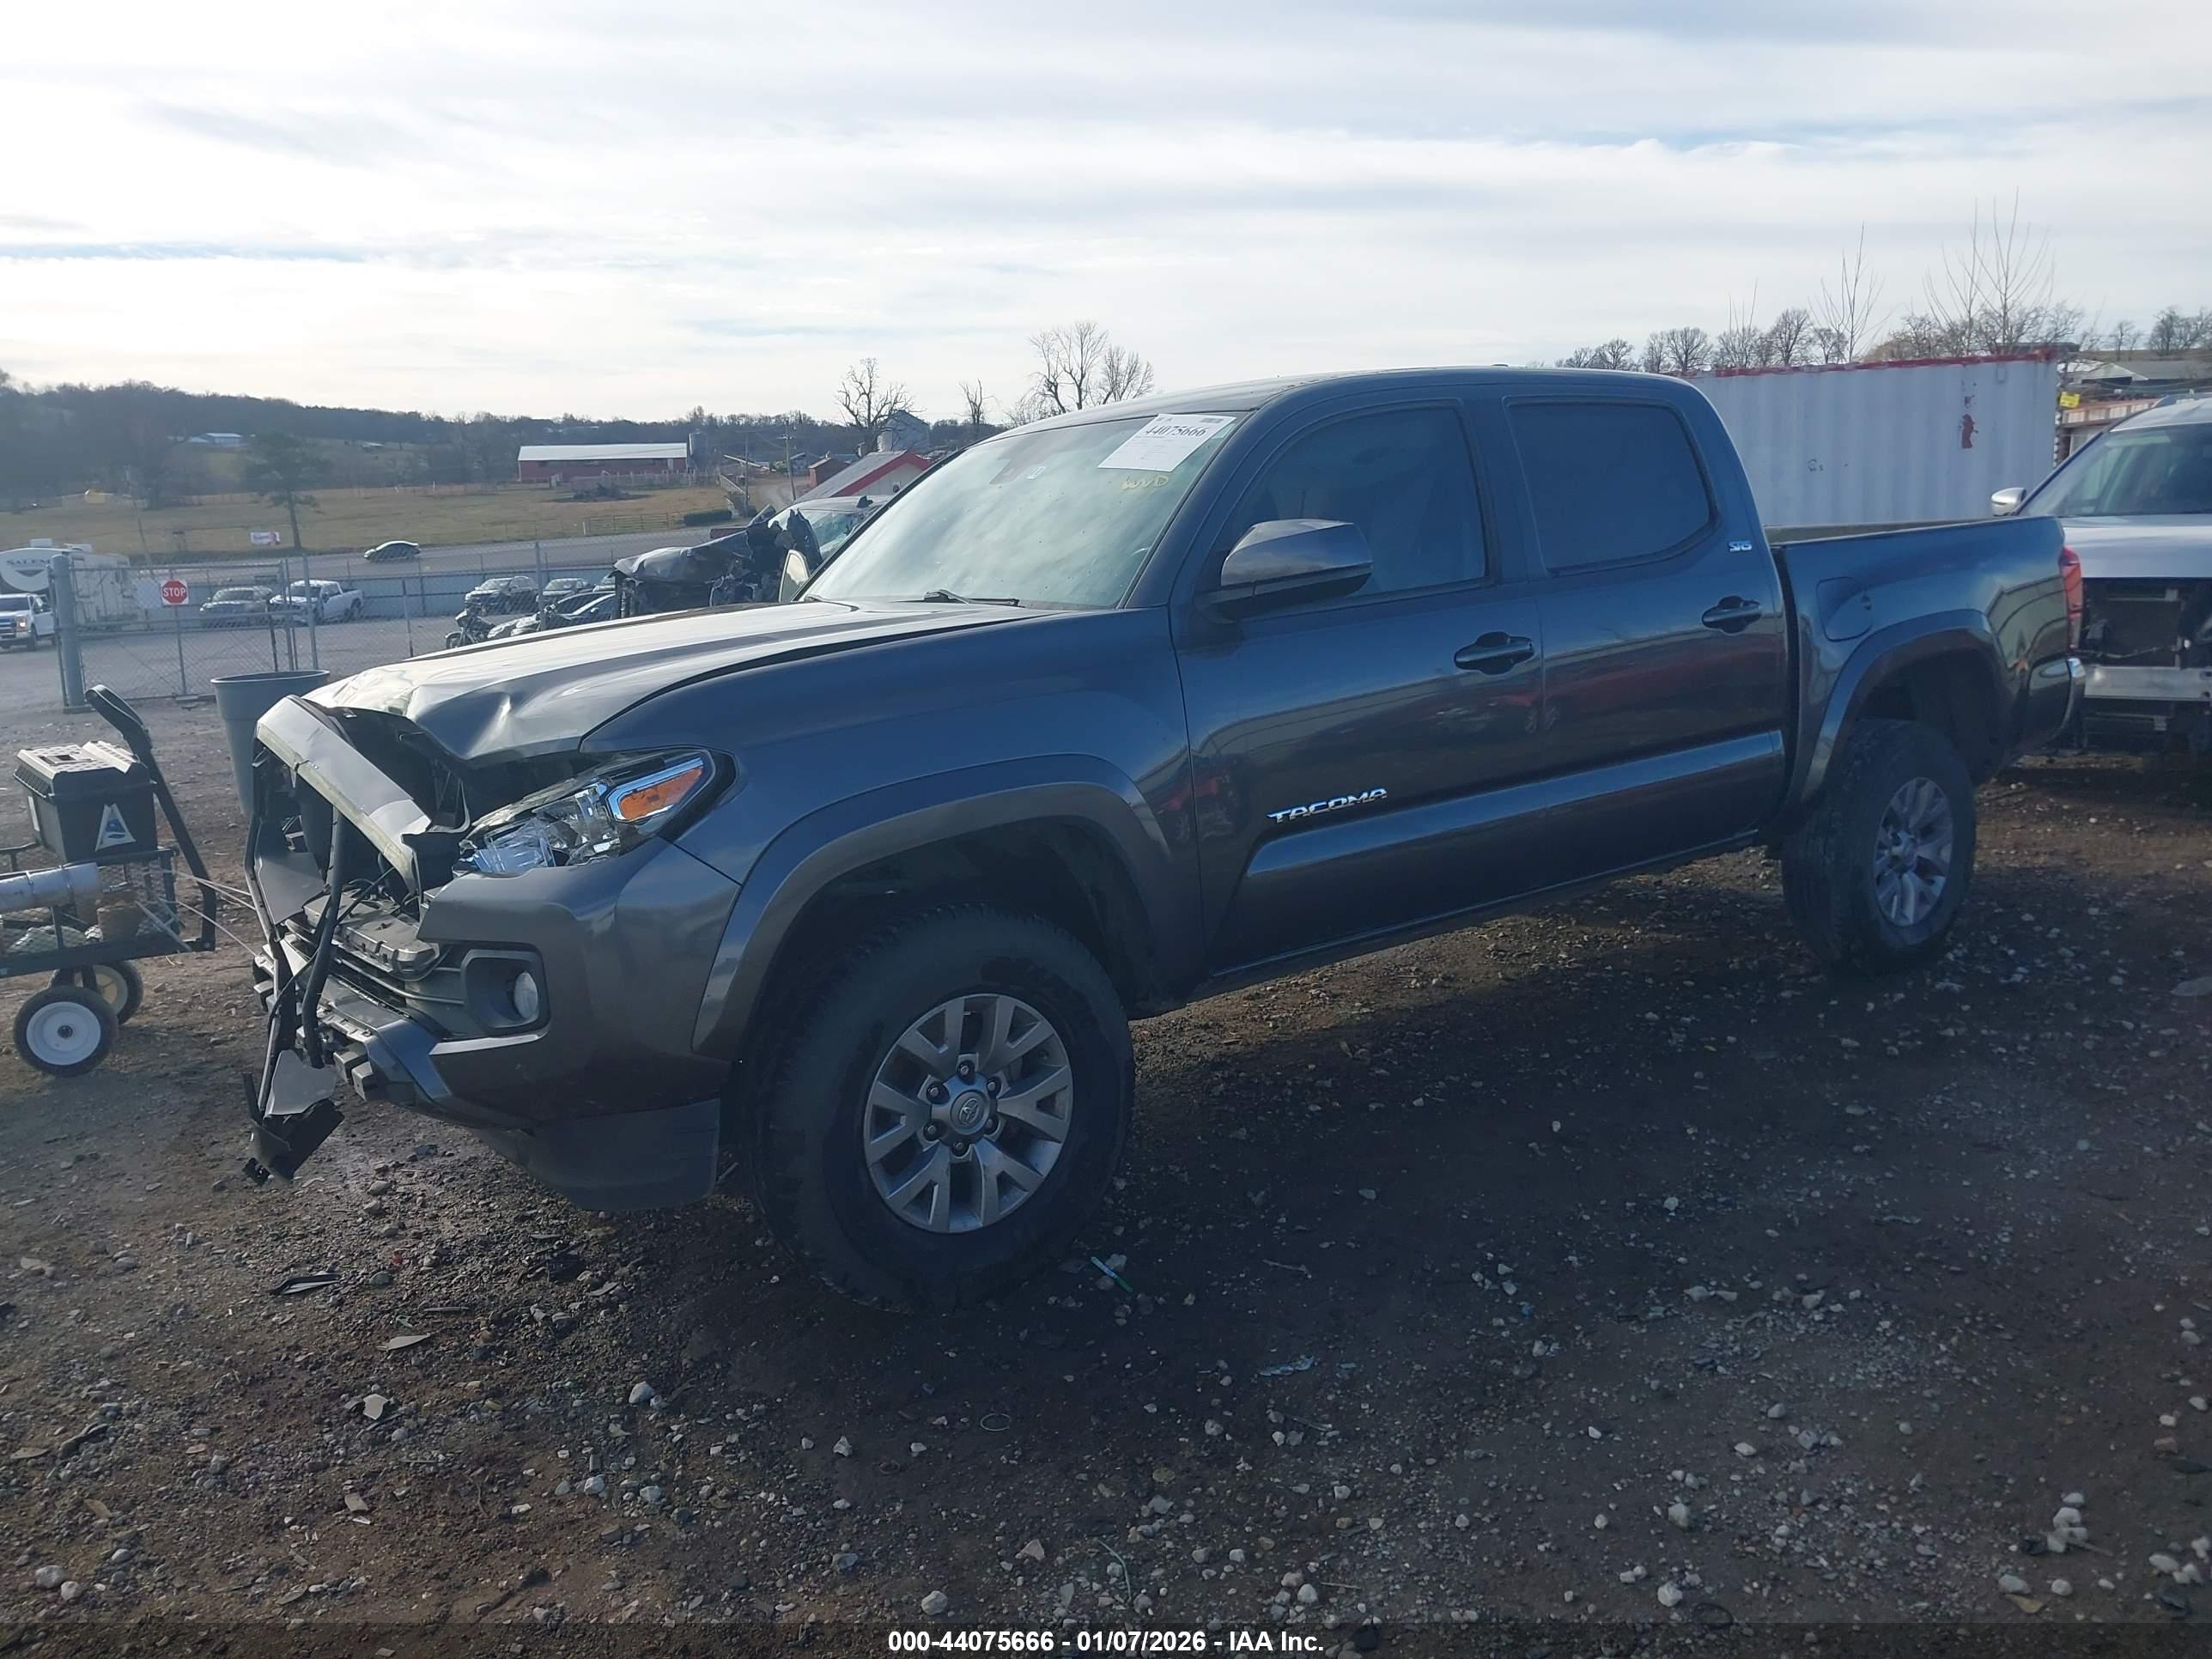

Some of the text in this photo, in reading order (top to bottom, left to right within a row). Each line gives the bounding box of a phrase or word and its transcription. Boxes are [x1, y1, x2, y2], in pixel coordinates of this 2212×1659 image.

[1145, 425, 1210, 437] 44075666
[163, 587, 186, 597] STOP
[1266, 787, 1389, 824] TACOMA
